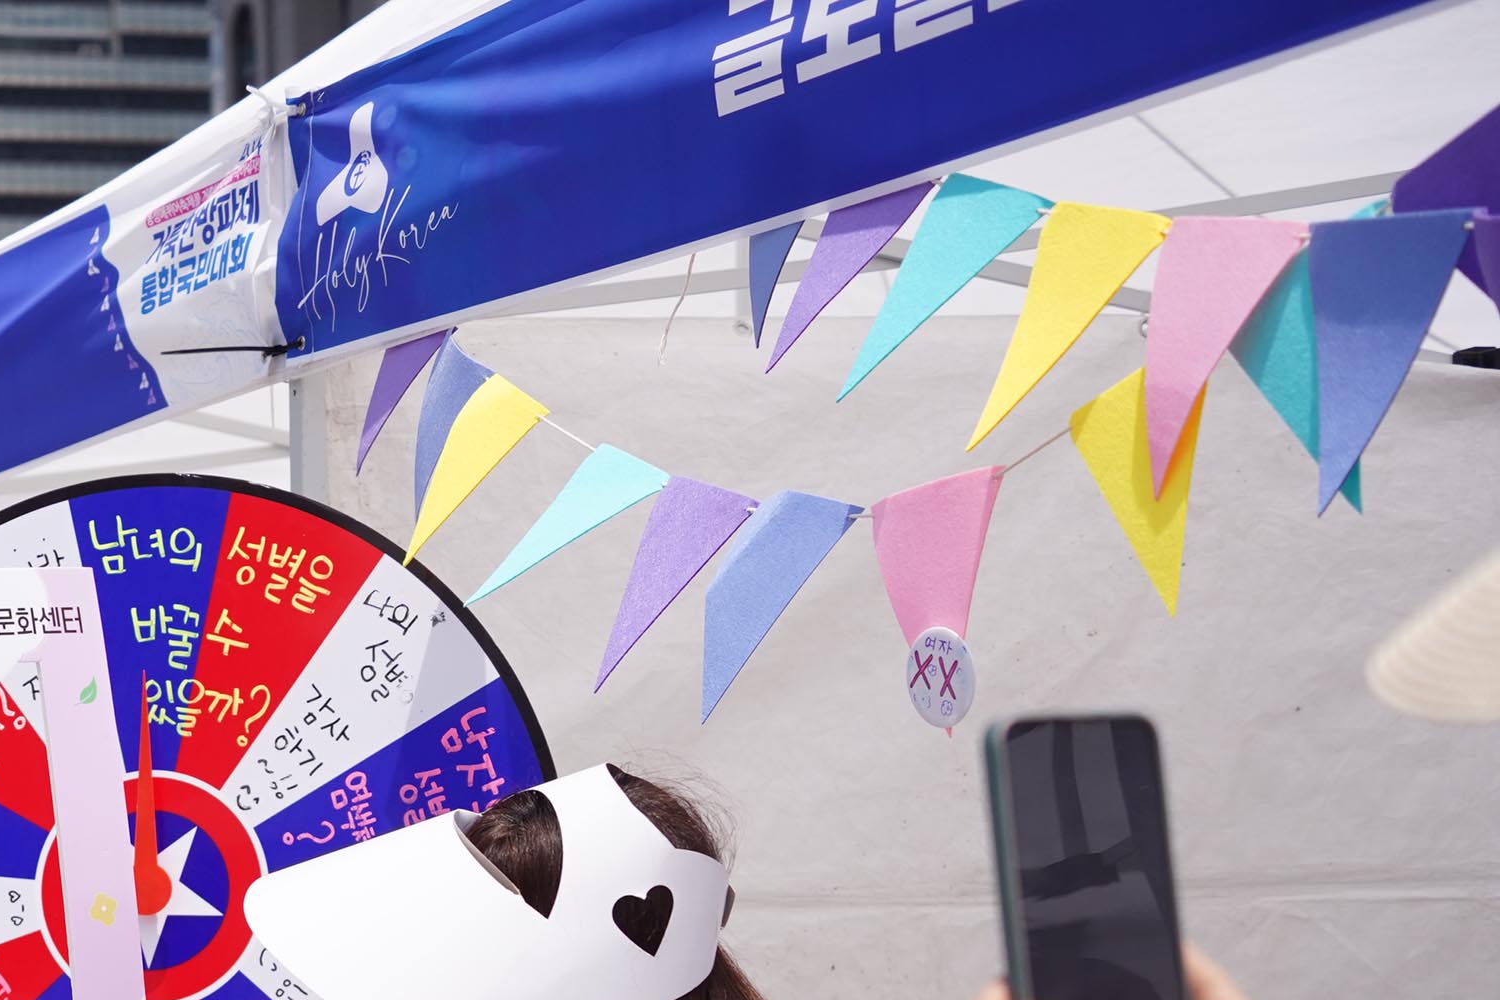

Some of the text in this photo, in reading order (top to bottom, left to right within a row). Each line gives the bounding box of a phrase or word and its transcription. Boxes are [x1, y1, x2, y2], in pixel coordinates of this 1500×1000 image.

[146, 179, 260, 265] 거룩한방파제
[140, 231, 254, 316] 통합국민대회
[298, 222, 372, 333] Holy
[375, 184, 460, 287] Korea
[88, 514, 335, 615] 남녀의 성별을
[206, 607, 250, 656] 수
[363, 589, 419, 636] 나의
[925, 636, 953, 654] 여자
[303, 683, 351, 743] 감사
[274, 725, 324, 777] 하기
